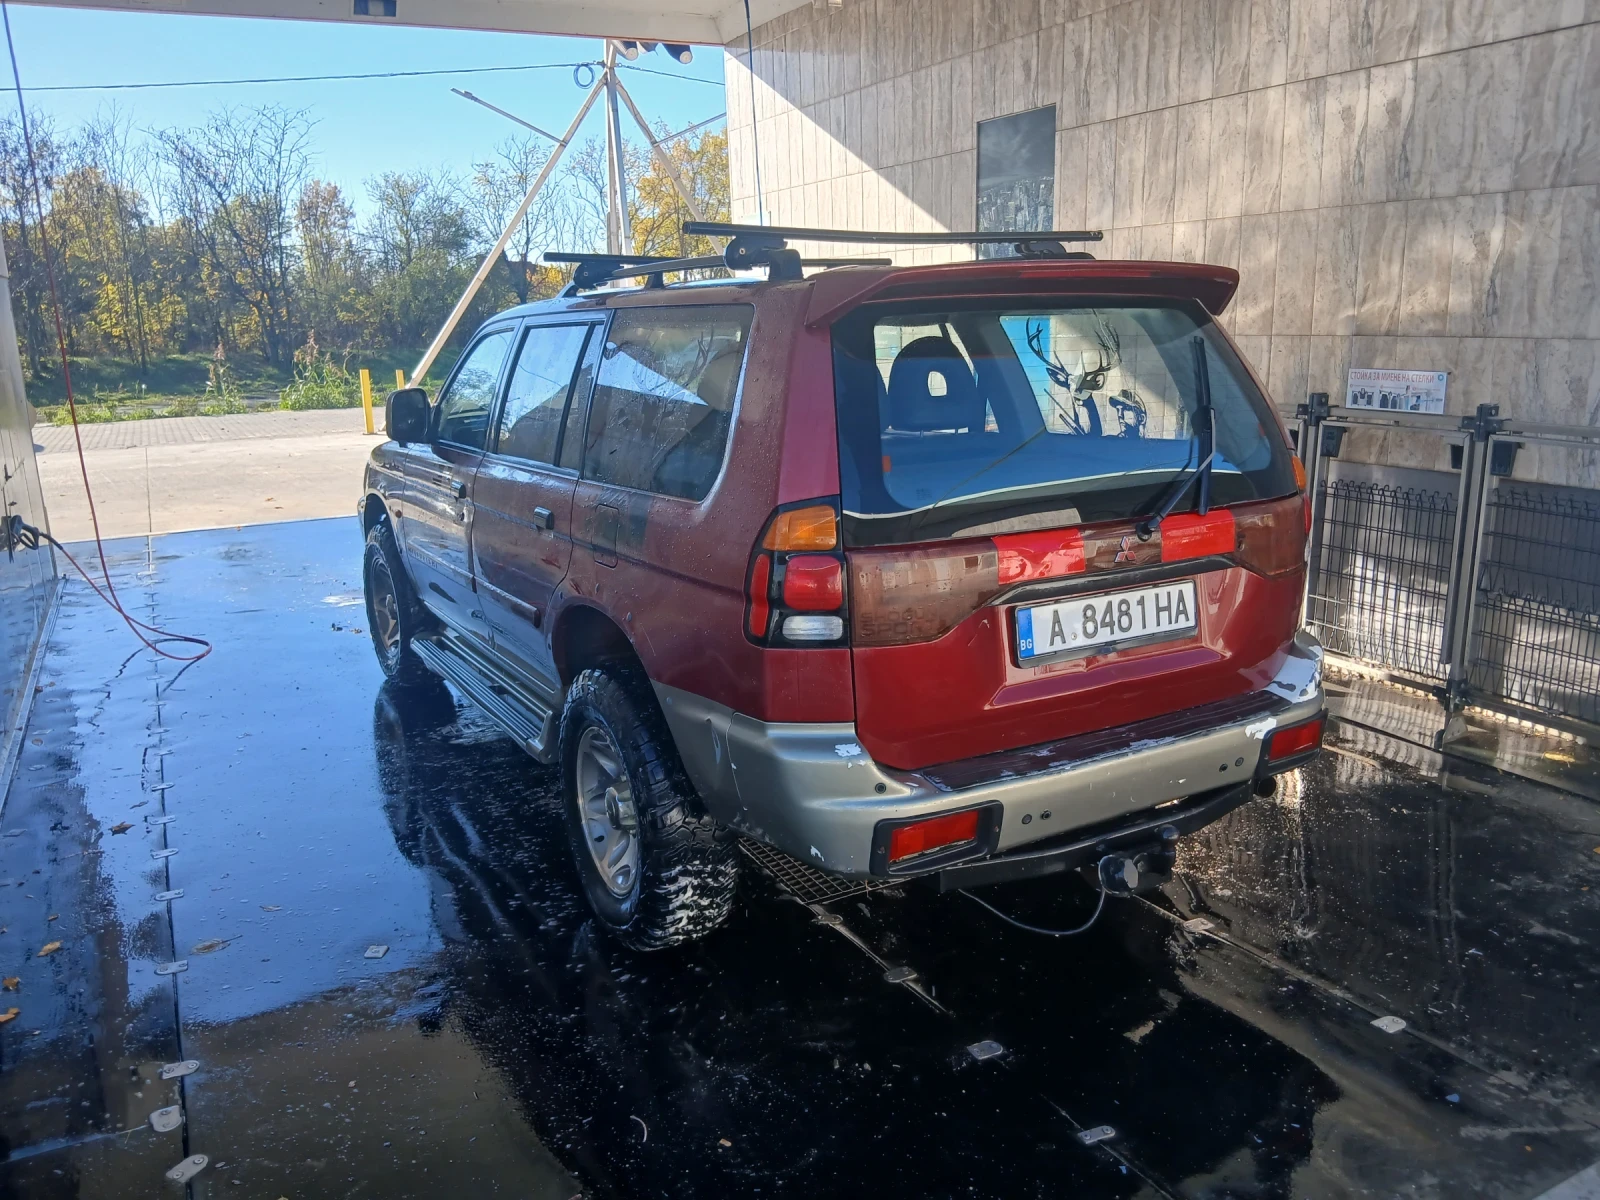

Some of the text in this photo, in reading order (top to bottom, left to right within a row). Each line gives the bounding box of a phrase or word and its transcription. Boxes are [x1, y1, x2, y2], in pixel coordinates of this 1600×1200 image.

[1350, 370, 1435, 384] СТОЙКА ЗА МИЕНЕ НА СТЕЛКИ
[1049, 609, 1066, 646] A
[1020, 638, 1033, 650] BG
